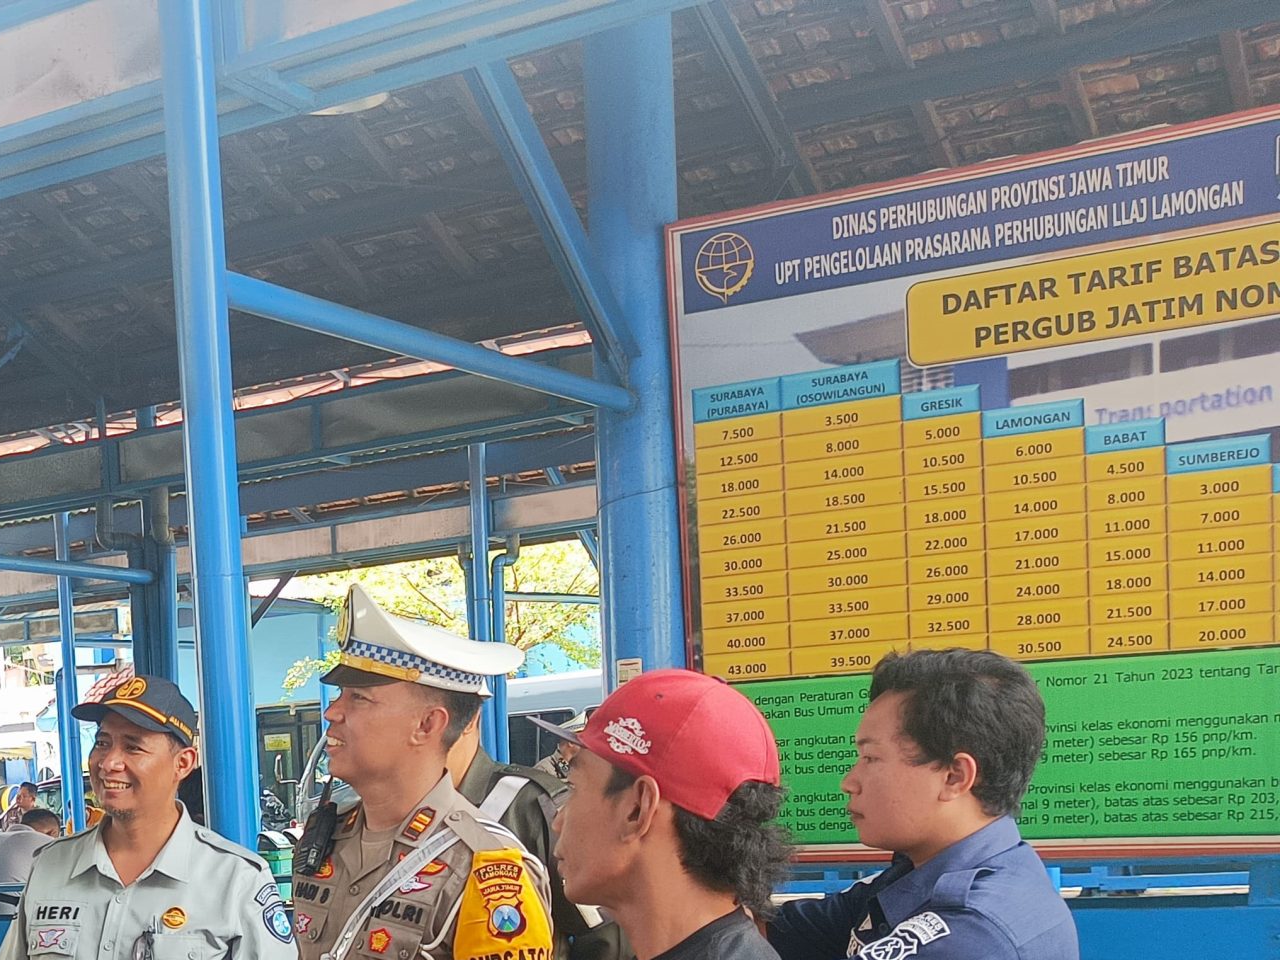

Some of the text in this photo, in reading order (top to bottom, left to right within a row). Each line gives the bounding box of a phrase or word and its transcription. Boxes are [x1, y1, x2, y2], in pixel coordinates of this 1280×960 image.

[832, 155, 1170, 240] DINAS PERHUBUNGAN PROVINSI JAWA TIMUR
[774, 180, 1244, 285] UPT PENGELOLAAN PRASARANA PERHUBUNGAN LLAJ LAMONGAN
[942, 241, 1280, 315] DAFTAR TARIF BATAS
[974, 310, 1096, 349] PERGUB
[1105, 293, 1204, 329] JATIM
[812, 370, 868, 387] SURABAYA
[711, 387, 764, 402] SURABAYA
[796, 381, 887, 406] (OSOWILANGUN)
[707, 400, 770, 418] (PURABAYA)
[921, 398, 962, 411] GRESIK
[826, 412, 858, 426] 3.500
[996, 411, 1071, 430] LAMONGAN
[723, 427, 755, 441] 7.500
[926, 426, 960, 439] 5.000
[1104, 431, 1146, 445] BABAT
[826, 439, 859, 452] 8.000
[1016, 442, 1052, 456] 6.000
[721, 453, 758, 466] 12.500
[923, 453, 964, 468] 10.500
[1179, 448, 1260, 467] SUMBEREJO
[824, 465, 864, 480] 14.000
[1107, 461, 1144, 474] 4.500
[1014, 470, 1056, 485] 10.500
[722, 479, 759, 492] 18.000
[924, 481, 965, 495] 15.500
[1200, 480, 1239, 494] 3.000
[826, 492, 865, 506] 18.500
[1108, 490, 1145, 504] 8.000
[723, 506, 760, 519] 22.500
[1014, 499, 1057, 513] 14.000
[925, 509, 966, 523] 18.000
[1201, 509, 1239, 523] 7.000
[826, 520, 865, 534] 21.500
[1105, 519, 1149, 532] 11.000
[723, 532, 761, 545] 26.000
[1016, 527, 1058, 541] 17.000
[925, 537, 967, 550] 22.000
[1198, 539, 1244, 553] 11.000
[827, 547, 867, 560] 25.000
[1106, 547, 1150, 561] 15.000
[724, 558, 762, 571] 30.000
[1016, 556, 1059, 569] 21.000
[926, 565, 969, 579] 26.000
[1199, 568, 1245, 582] 14.000
[828, 574, 868, 587] 30.000
[1107, 576, 1151, 590] 18.000
[725, 584, 765, 598] 33.500
[1017, 584, 1059, 597] 24.000
[927, 592, 968, 604] 29.000
[1199, 598, 1245, 612] 17.000
[829, 600, 868, 613] 33.500
[1107, 605, 1151, 618] 21.500
[726, 610, 764, 622] 37.000
[1018, 613, 1060, 625] 28.000
[928, 620, 969, 632] 32.500
[830, 627, 869, 640] 37.000
[1108, 634, 1152, 647] 24.500
[1199, 628, 1246, 641] 20.000
[727, 637, 765, 648] 40.000
[1018, 641, 1061, 654] 30.500
[831, 655, 870, 667] 39.500
[728, 663, 766, 677] 43.000
[1046, 676, 1087, 687] Nomor
[1093, 673, 1108, 684] 21
[1115, 671, 1155, 683] Tahun
[1161, 668, 1193, 680] 2023
[1199, 665, 1251, 679] tentang
[754, 694, 794, 706] dengan
[800, 690, 854, 702] Peraturan
[794, 704, 854, 718] Bus Umum
[1081, 719, 1113, 732] kelas
[1117, 717, 1171, 731] ekonomi
[1176, 713, 1269, 730] menggunakan
[794, 735, 846, 748] angkutan
[1053, 728, 1258, 750] meter) sebesar Rp 156 pnp/km.
[794, 749, 814, 761] bus
[1041, 745, 1257, 764] 9 meter) sebesar Rp 165 pnp/km.
[795, 763, 814, 775] bus
[1027, 782, 1075, 795] Provinsi
[1079, 781, 1111, 794] kelas
[1115, 780, 1169, 793] ekonomi
[1173, 778, 1266, 793] menggunakan
[793, 792, 845, 805] angkutan
[1042, 801, 1050, 811] 9
[1054, 797, 1100, 812] meter),
[1104, 796, 1138, 808] batas
[1142, 795, 1168, 808] atas
[1173, 793, 1222, 807] sebesar
[1227, 793, 1245, 806] Rp
[796, 806, 815, 818] bus
[1041, 808, 1245, 827] 9 meter), batas atas sebesar Rp
[796, 821, 816, 833] bus
[479, 864, 519, 875] POLRES
[36, 905, 80, 920] HERI
